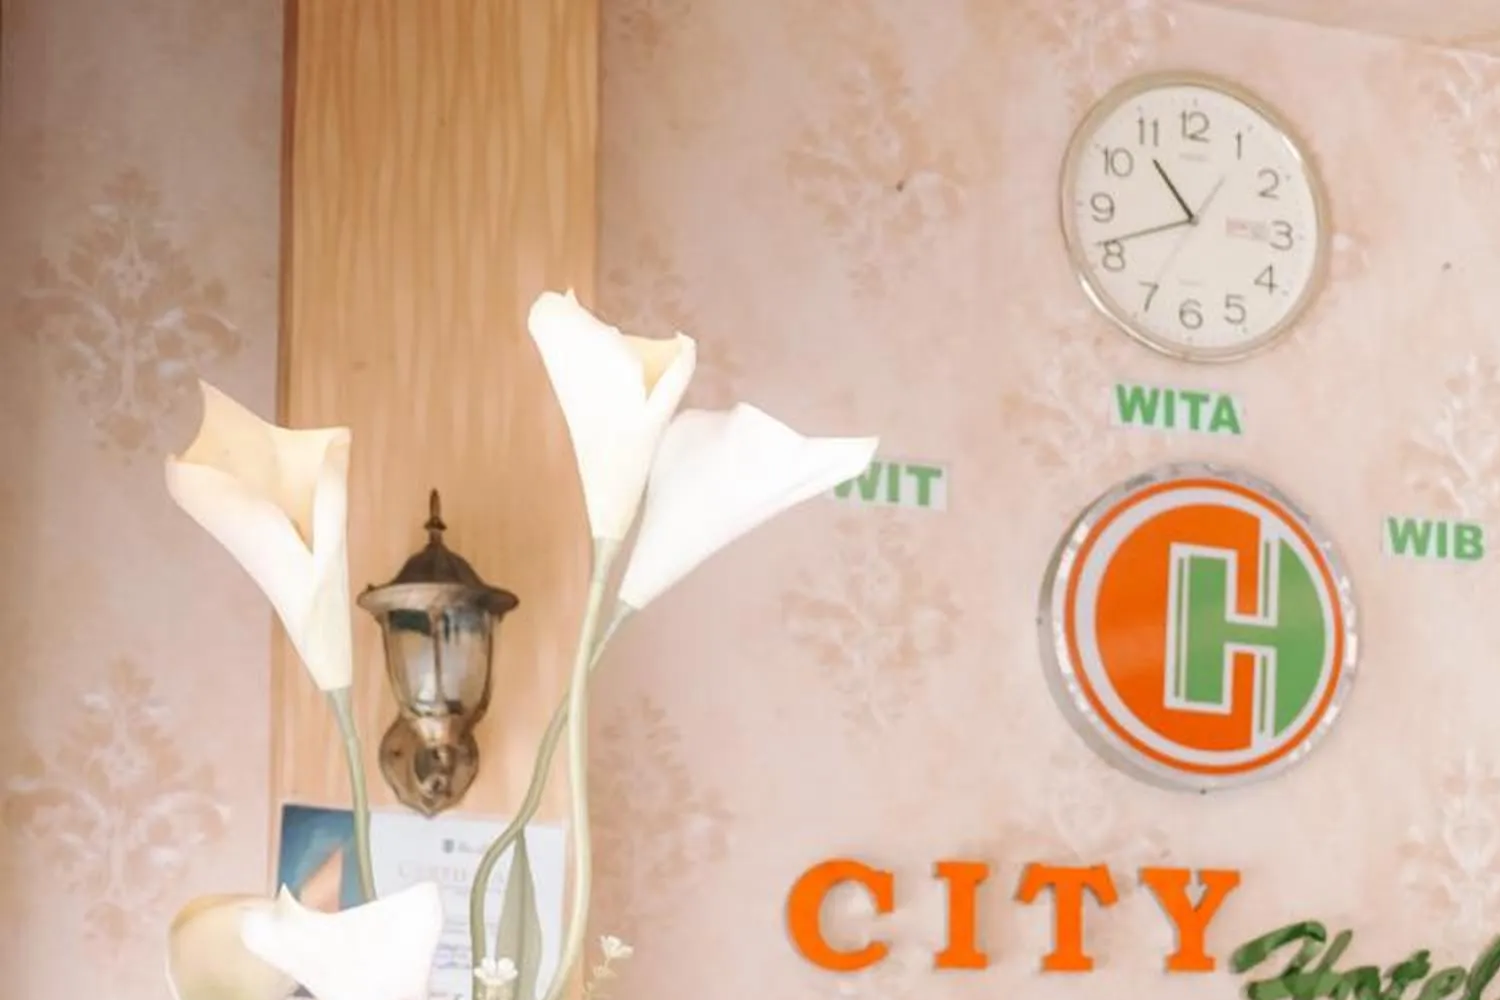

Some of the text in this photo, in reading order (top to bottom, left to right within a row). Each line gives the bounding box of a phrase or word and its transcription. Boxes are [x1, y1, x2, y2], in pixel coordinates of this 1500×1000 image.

[1136, 116, 1159, 147] 11
[1180, 110, 1211, 143] 12
[1234, 131, 1243, 160] 1
[1103, 147, 1134, 178] 10
[1257, 168, 1280, 200] 2
[1090, 192, 1115, 223] 9
[1268, 220, 1294, 251] 3
[1101, 239, 1126, 272] 8
[1253, 263, 1278, 294] 4
[1138, 281, 1160, 313] 7
[1223, 293, 1247, 325] 5
[1178, 299, 1204, 330] 6
[1115, 384, 1243, 435] WITA
[1387, 516, 1485, 561] WIB
[785, 857, 1242, 974] CITY
